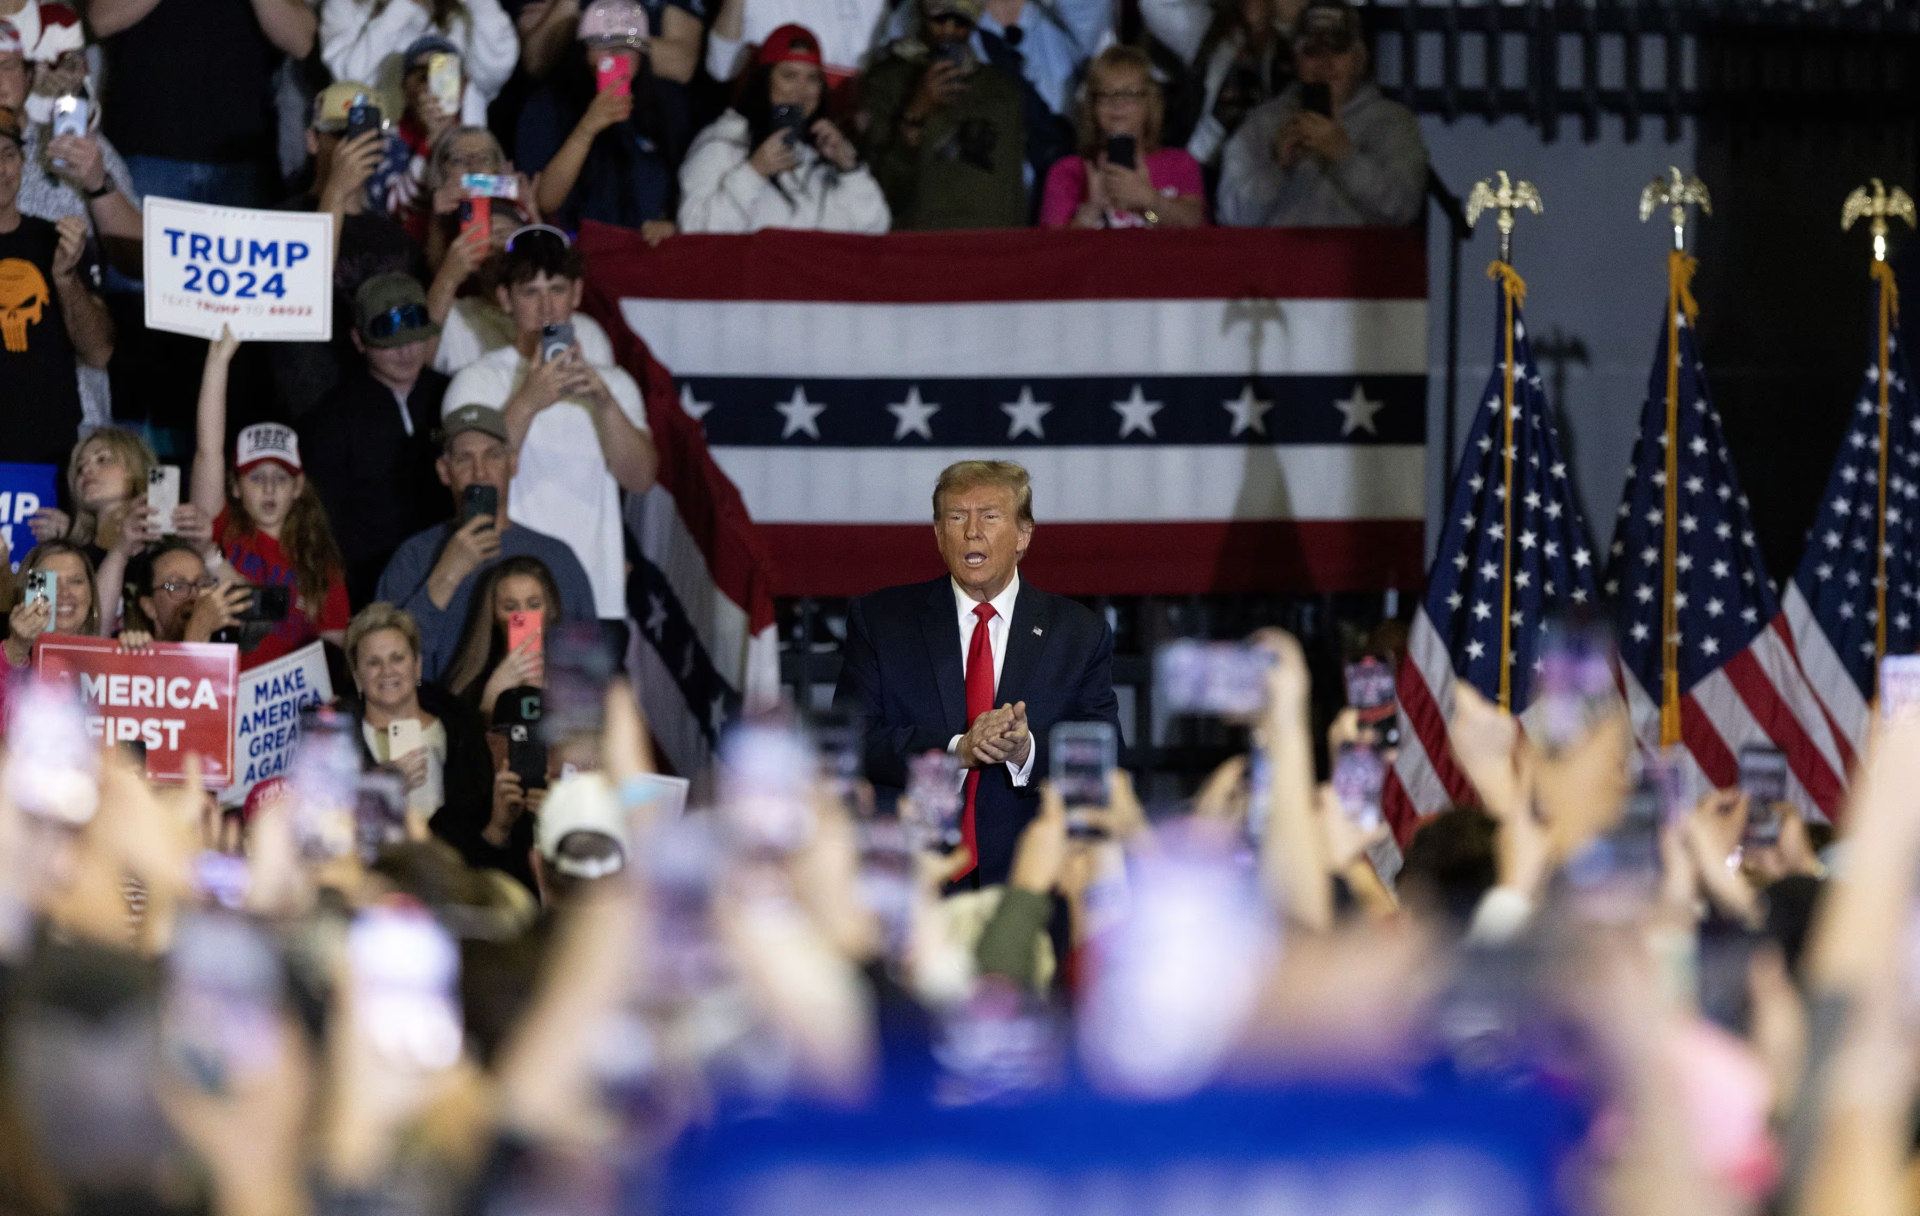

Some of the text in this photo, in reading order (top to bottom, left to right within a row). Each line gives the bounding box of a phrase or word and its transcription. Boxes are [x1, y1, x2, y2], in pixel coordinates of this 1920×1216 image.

[164, 228, 309, 268] TRUMP
[183, 264, 286, 299] 2024
[196, 299, 240, 314] TRUMP
[60, 671, 219, 710] MERICA
[255, 667, 306, 706] MAKE
[520, 695, 541, 720] C
[249, 722, 298, 758] GREA
[243, 749, 295, 786] AGAI
